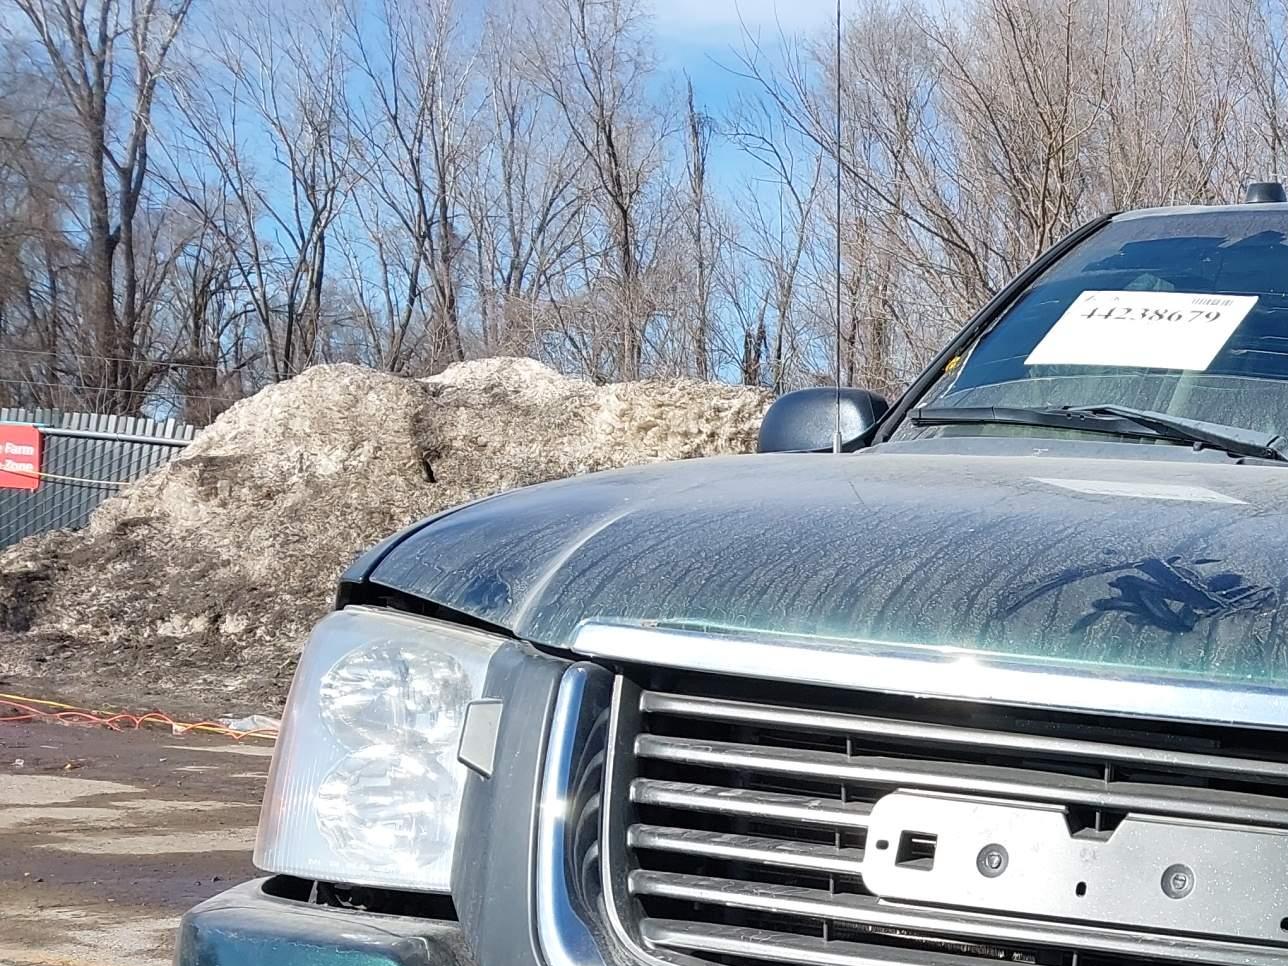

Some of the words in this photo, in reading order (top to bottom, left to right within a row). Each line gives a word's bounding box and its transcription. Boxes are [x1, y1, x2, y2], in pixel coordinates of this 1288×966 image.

[1081, 307, 1222, 323] 44238679
[4, 442, 34, 456] Farm
[4, 459, 33, 472] Zone
